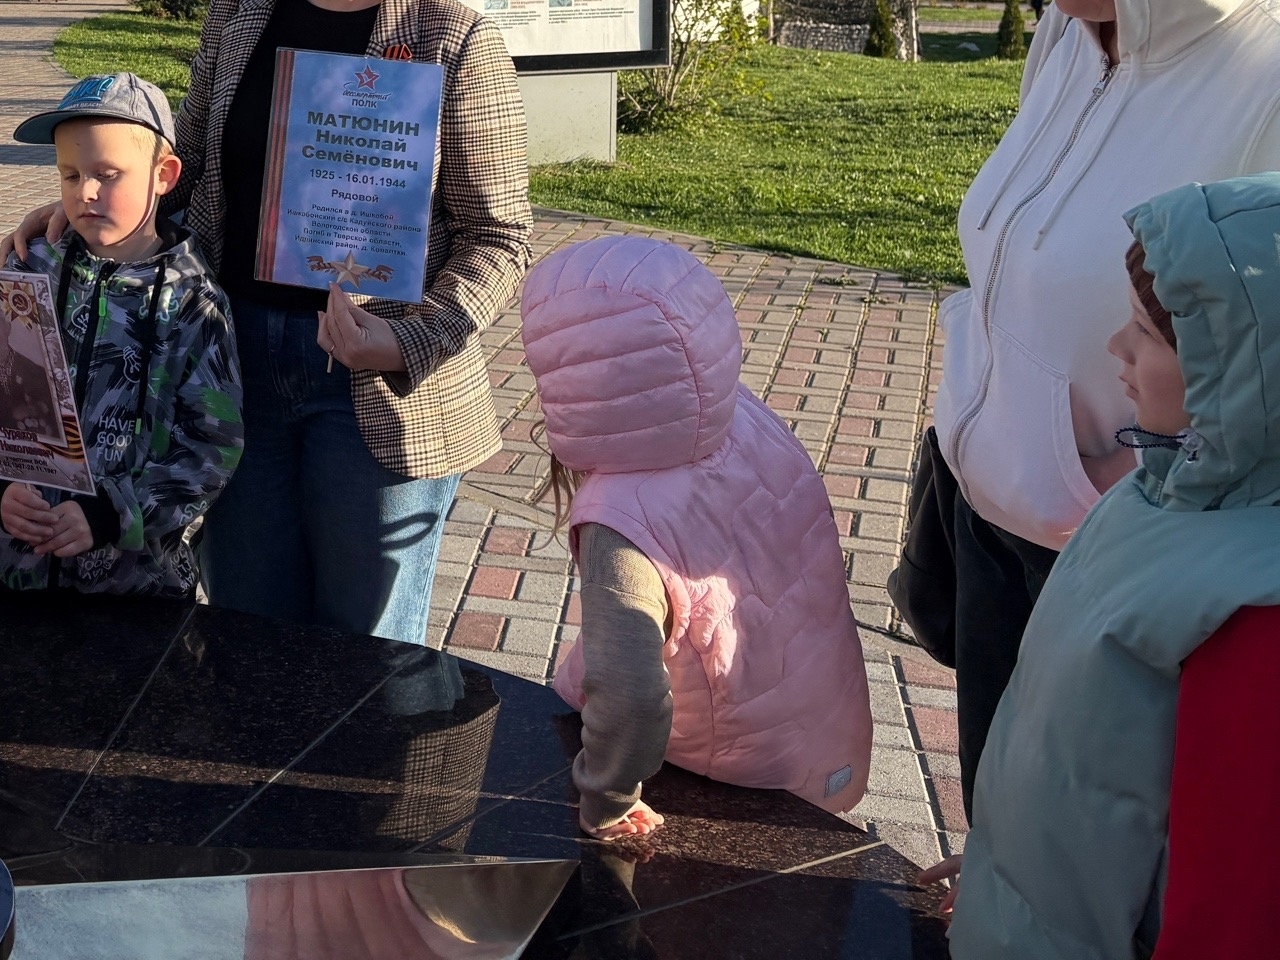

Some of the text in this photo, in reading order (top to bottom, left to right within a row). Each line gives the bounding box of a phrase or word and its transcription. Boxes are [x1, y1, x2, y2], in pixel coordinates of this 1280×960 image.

[307, 111, 420, 136] МАТЮНИН
[316, 129, 407, 153] Николай
[302, 145, 418, 171] Семёнович
[309, 168, 335, 180] 1925
[346, 173, 407, 189] 16.01.1944
[331, 189, 379, 203] Рядовой
[312, 204, 342, 214] Родился
[303, 227, 325, 236] Погиб
[311, 220, 359, 232] Вологодской
[394, 224, 422, 233] района
[335, 241, 360, 250] район,
[98, 416, 135, 432] HAVE
[97, 431, 132, 447] GOOD
[96, 446, 123, 462] FUN
